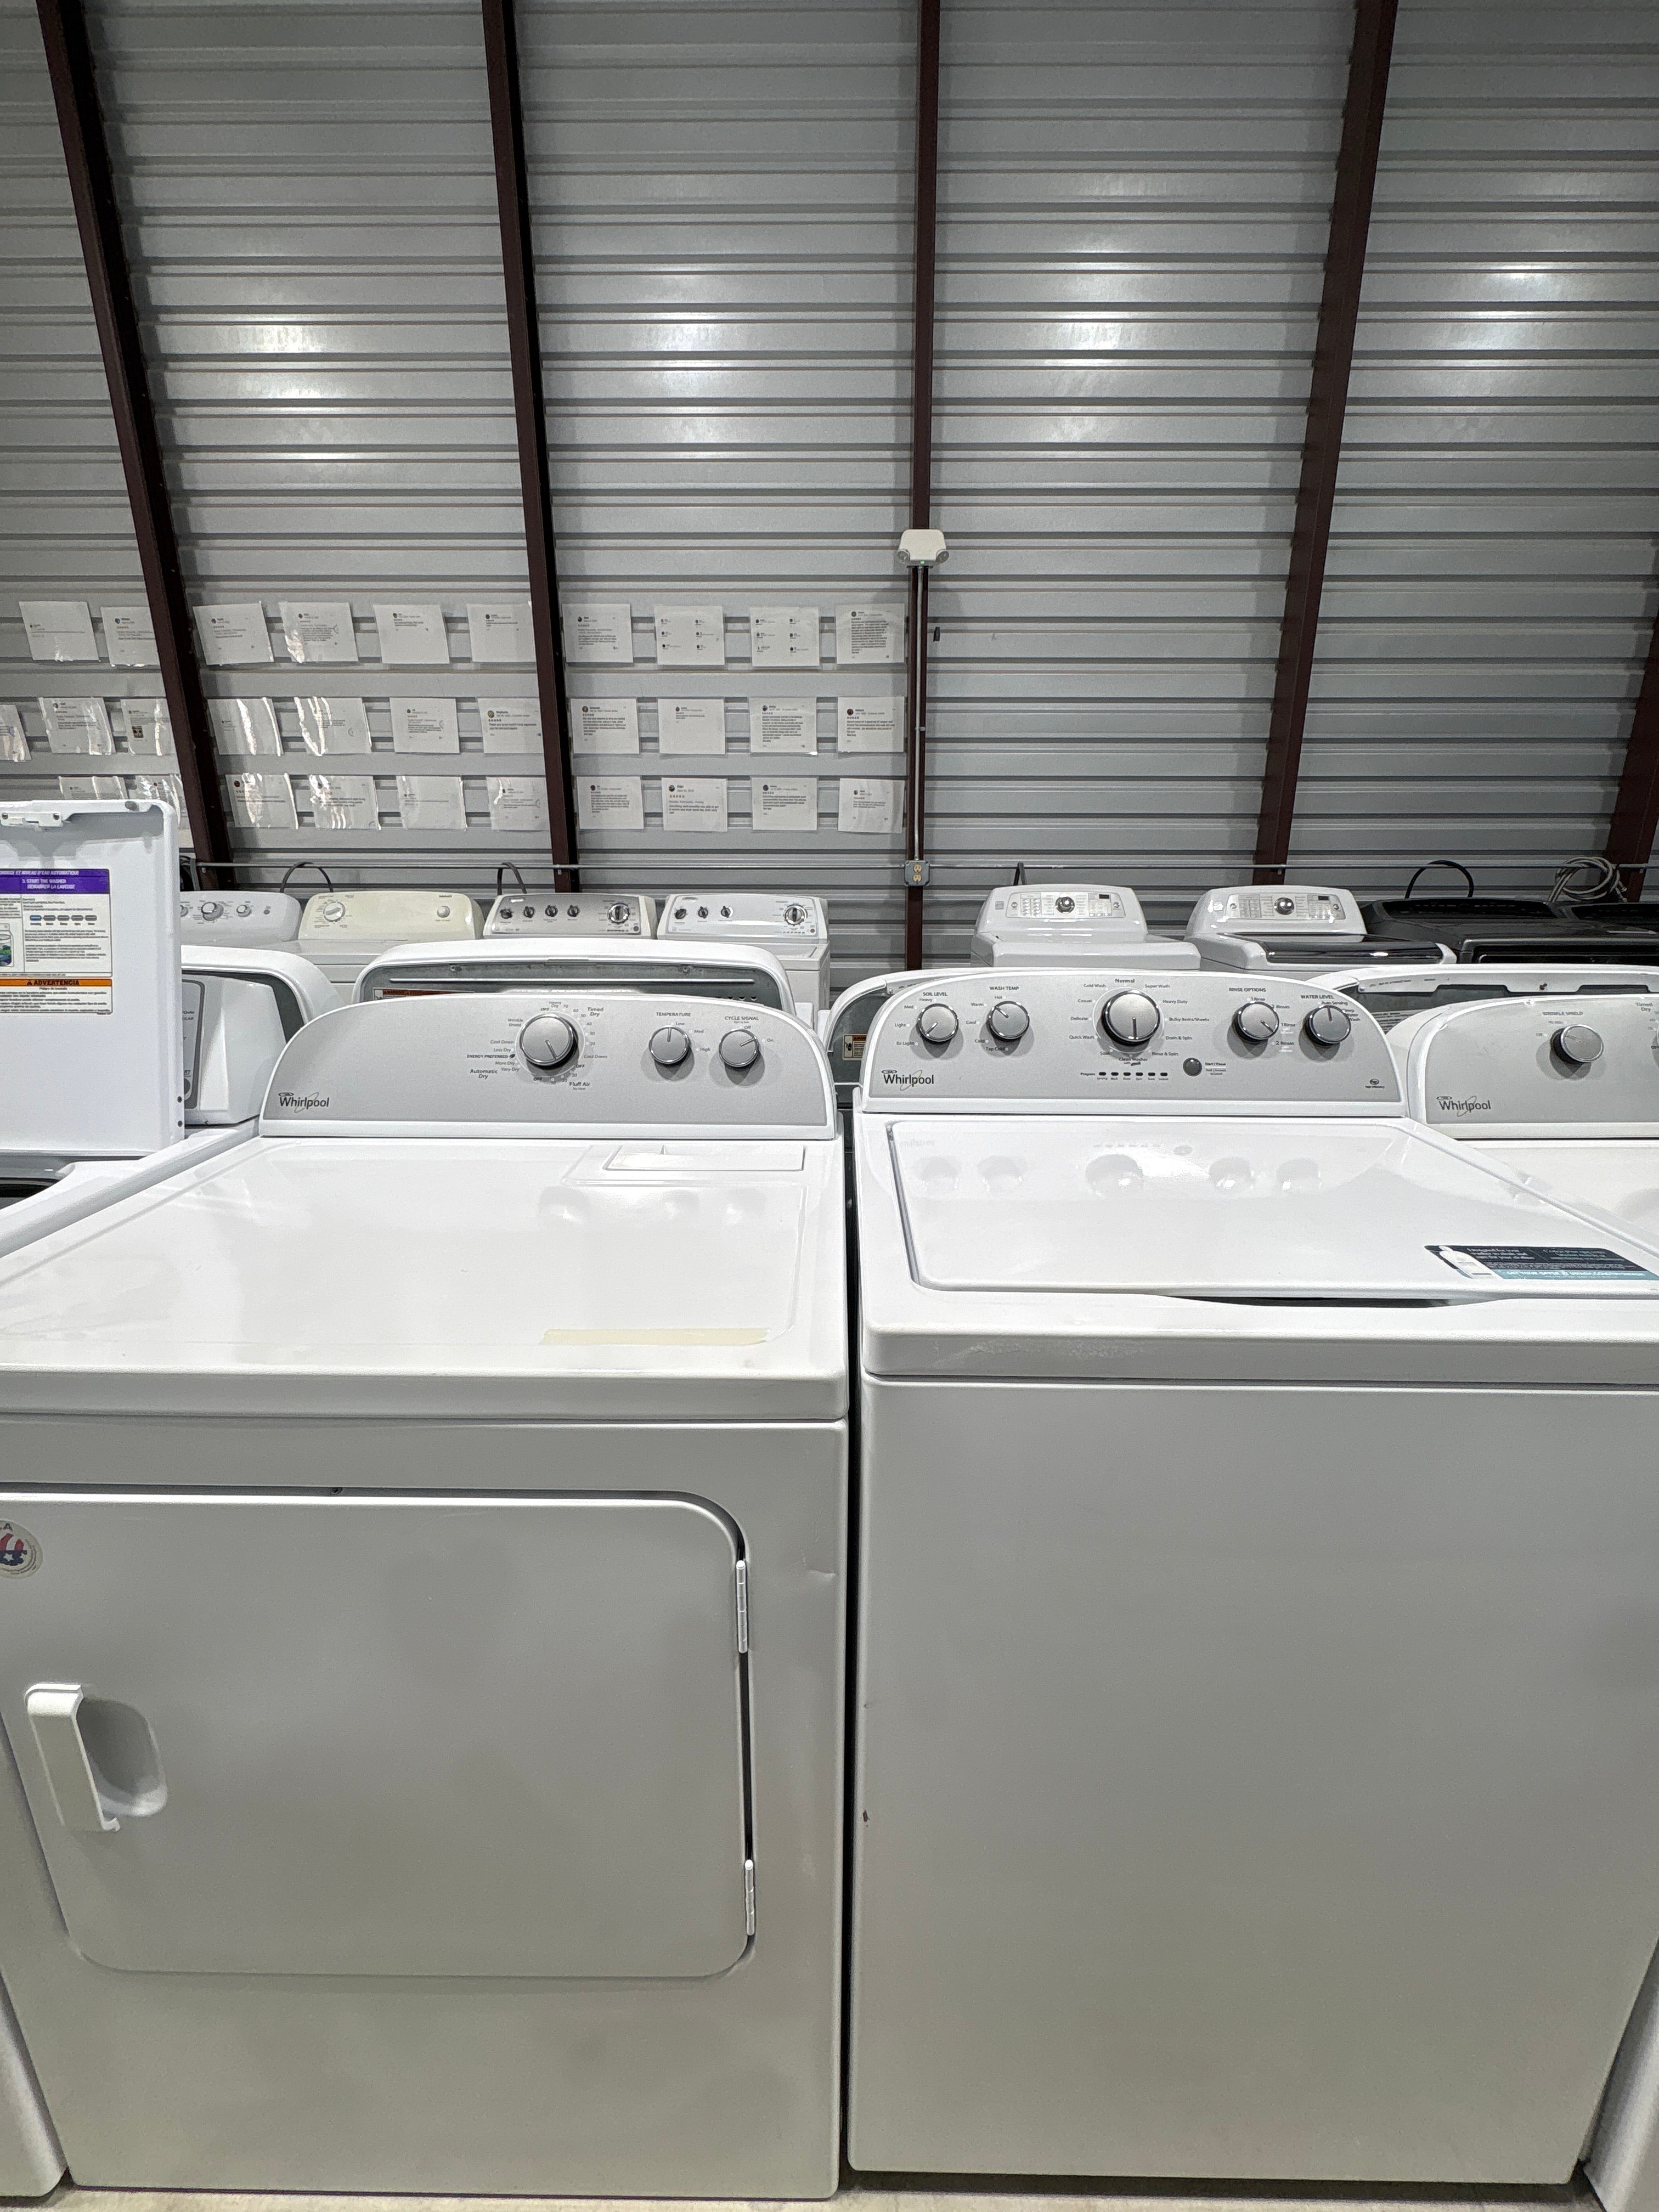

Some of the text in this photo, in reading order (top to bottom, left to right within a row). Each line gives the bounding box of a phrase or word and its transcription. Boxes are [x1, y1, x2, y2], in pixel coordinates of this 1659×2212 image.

[883, 1074, 934, 1088] Whirlpool
[279, 1097, 330, 1109] Whirlpool
[1438, 1100, 1491, 1113] Whirlpool
